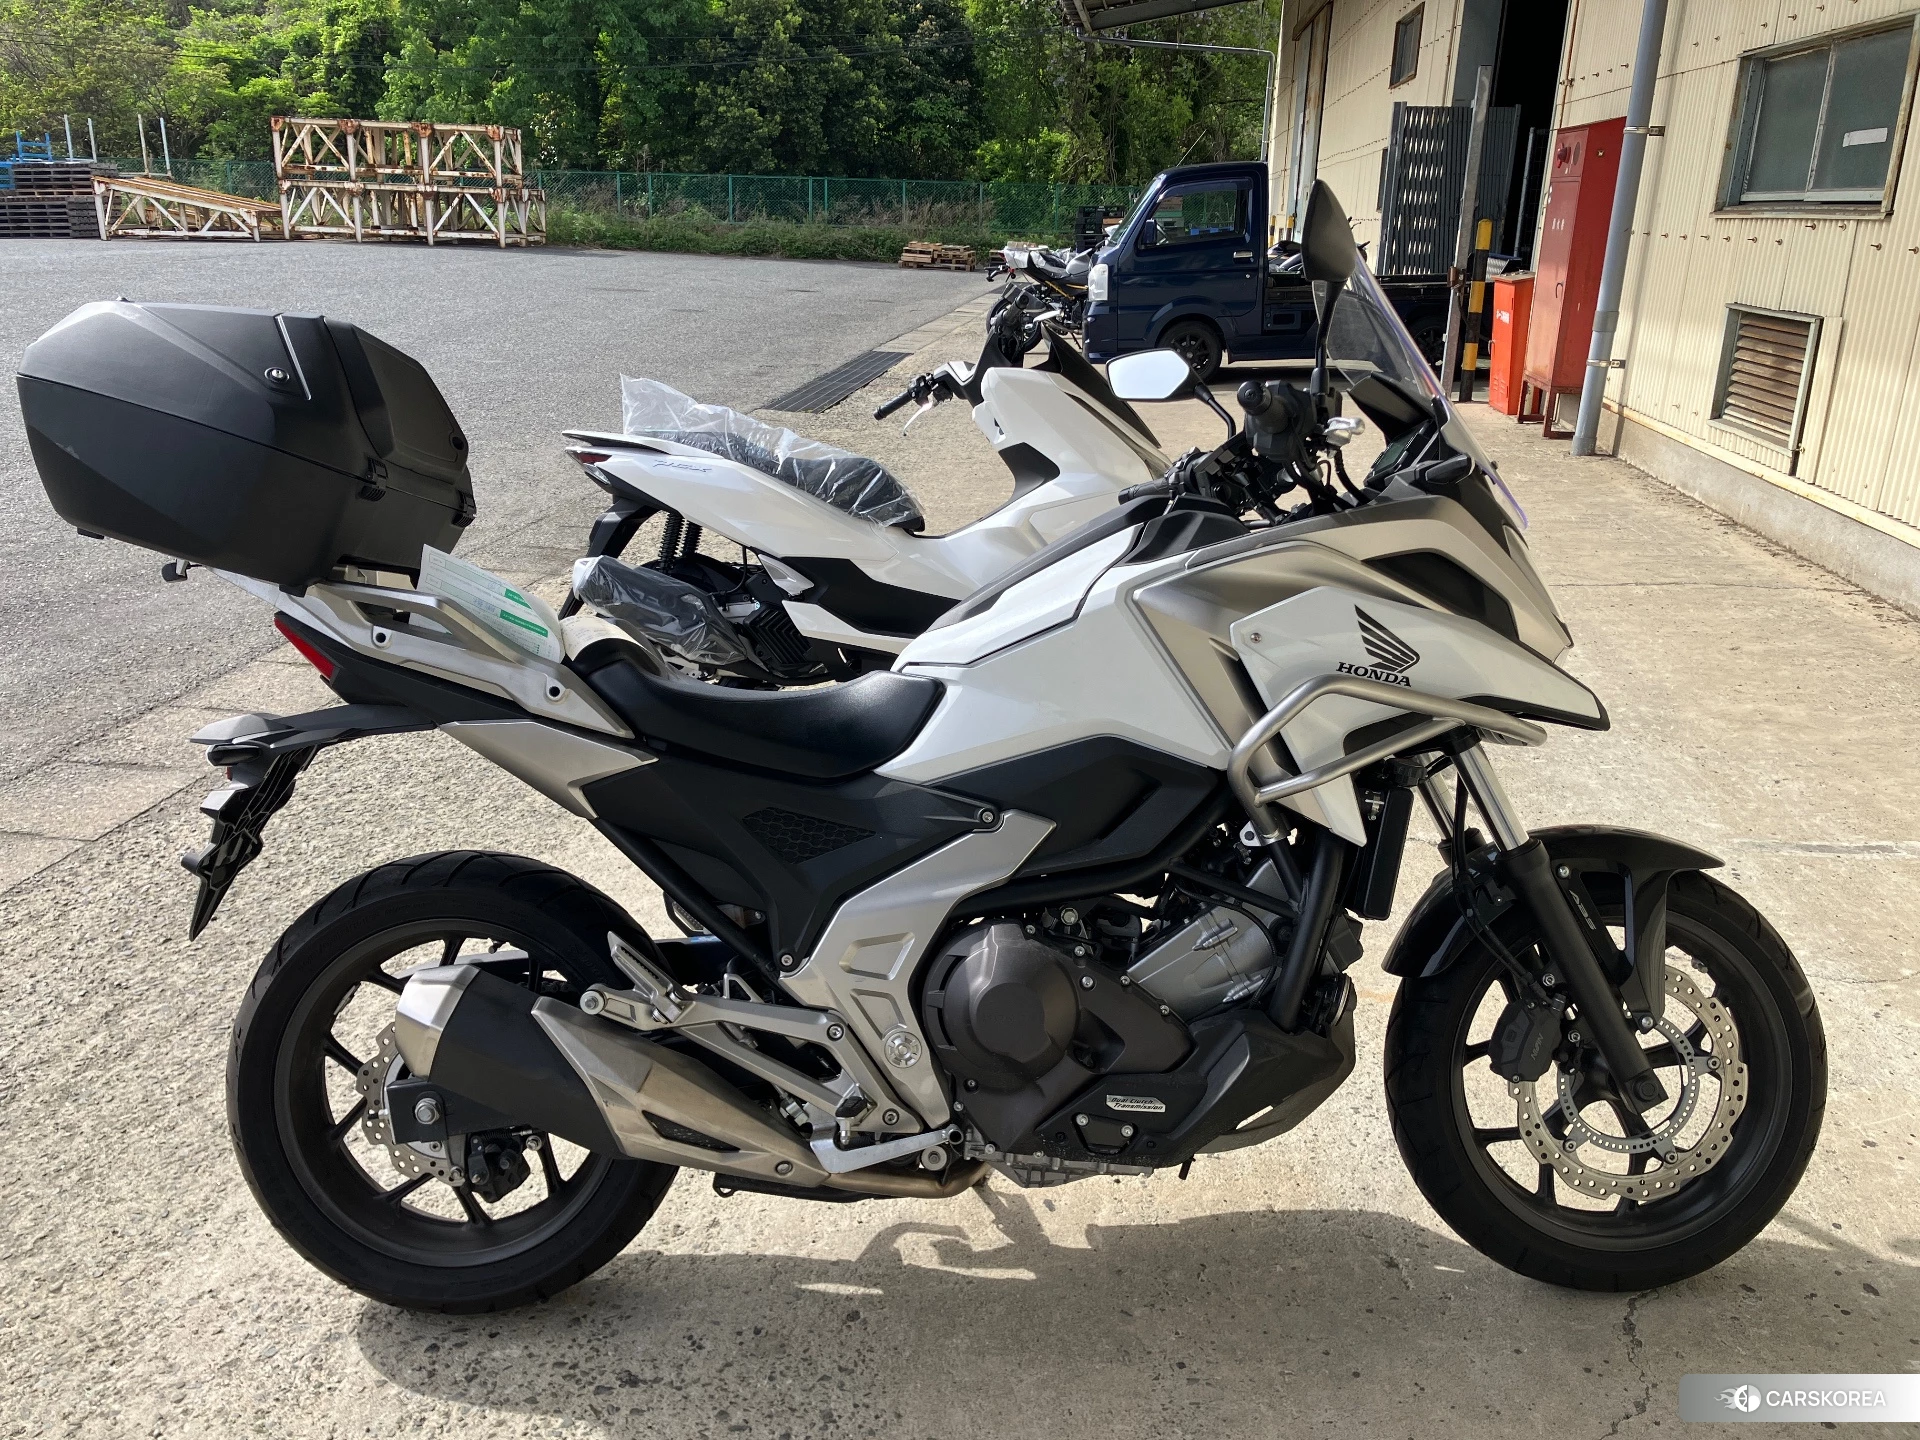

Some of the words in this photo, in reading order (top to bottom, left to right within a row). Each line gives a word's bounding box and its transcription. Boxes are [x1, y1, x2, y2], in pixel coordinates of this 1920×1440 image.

[1336, 661, 1412, 687] HONDA
[1569, 889, 1597, 930] ABS
[1113, 1102, 1164, 1110] Transmission
